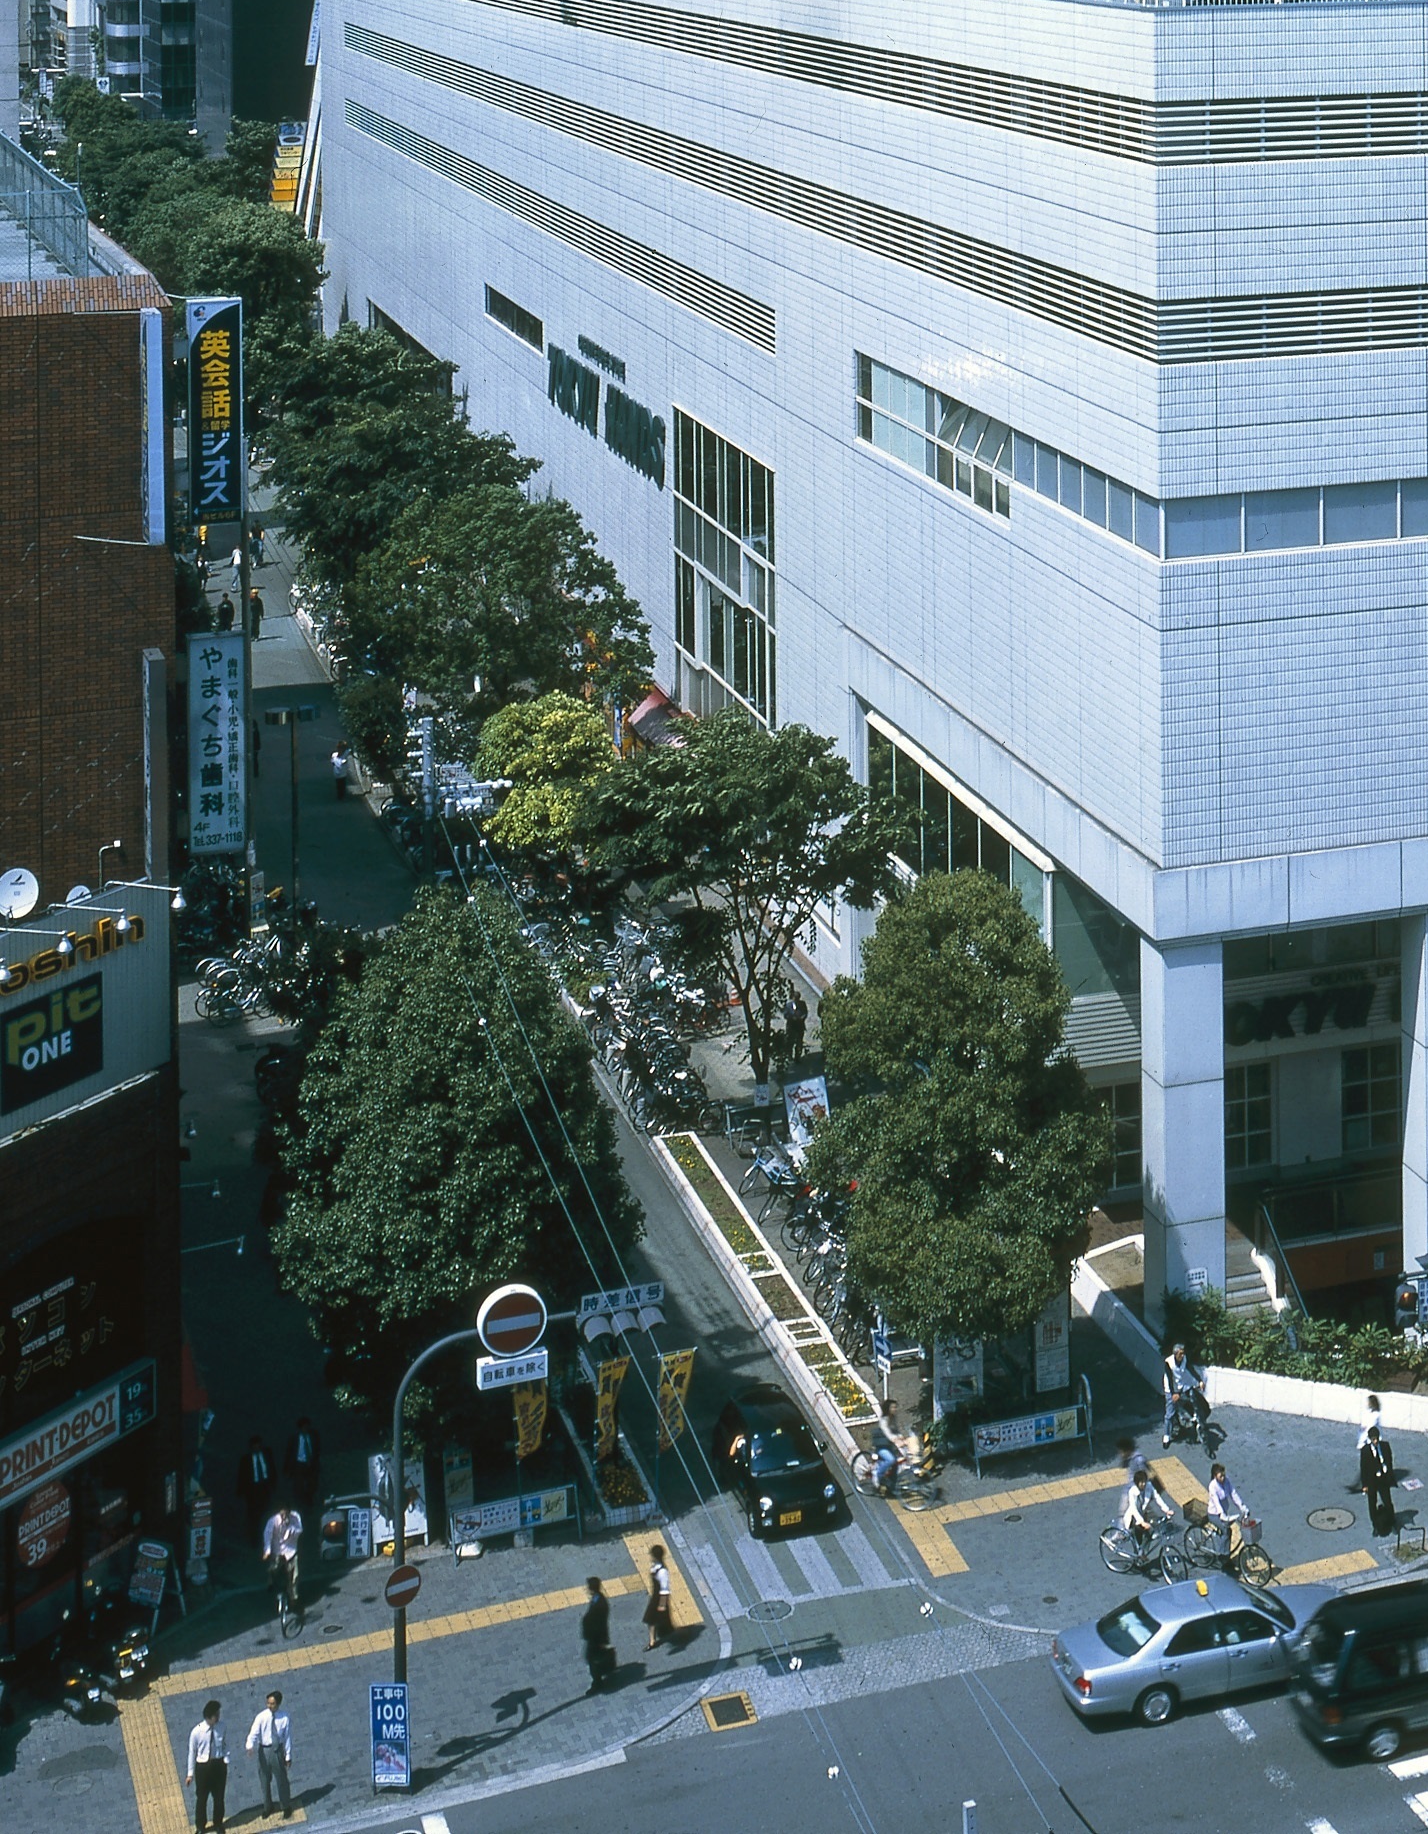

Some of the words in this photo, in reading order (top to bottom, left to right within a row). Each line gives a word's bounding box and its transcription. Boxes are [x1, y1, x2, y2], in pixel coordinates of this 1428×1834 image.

[200, 330, 231, 419] 英会話
[200, 432, 231, 505] ジオス
[199, 647, 225, 817] やまぐち歯科
[193, 822, 210, 833] 4F
[7, 983, 102, 1066] pit
[1224, 983, 1376, 1047] OKYU
[22, 1031, 72, 1071] ONE
[583, 1284, 662, 1312] 時差信号
[483, 1361, 545, 1383] 自転車を除く
[26, 1538, 48, 1567] 39
[373, 1688, 403, 1700] 工事中
[376, 1704, 405, 1721] 100
[382, 1723, 405, 1740] M先
